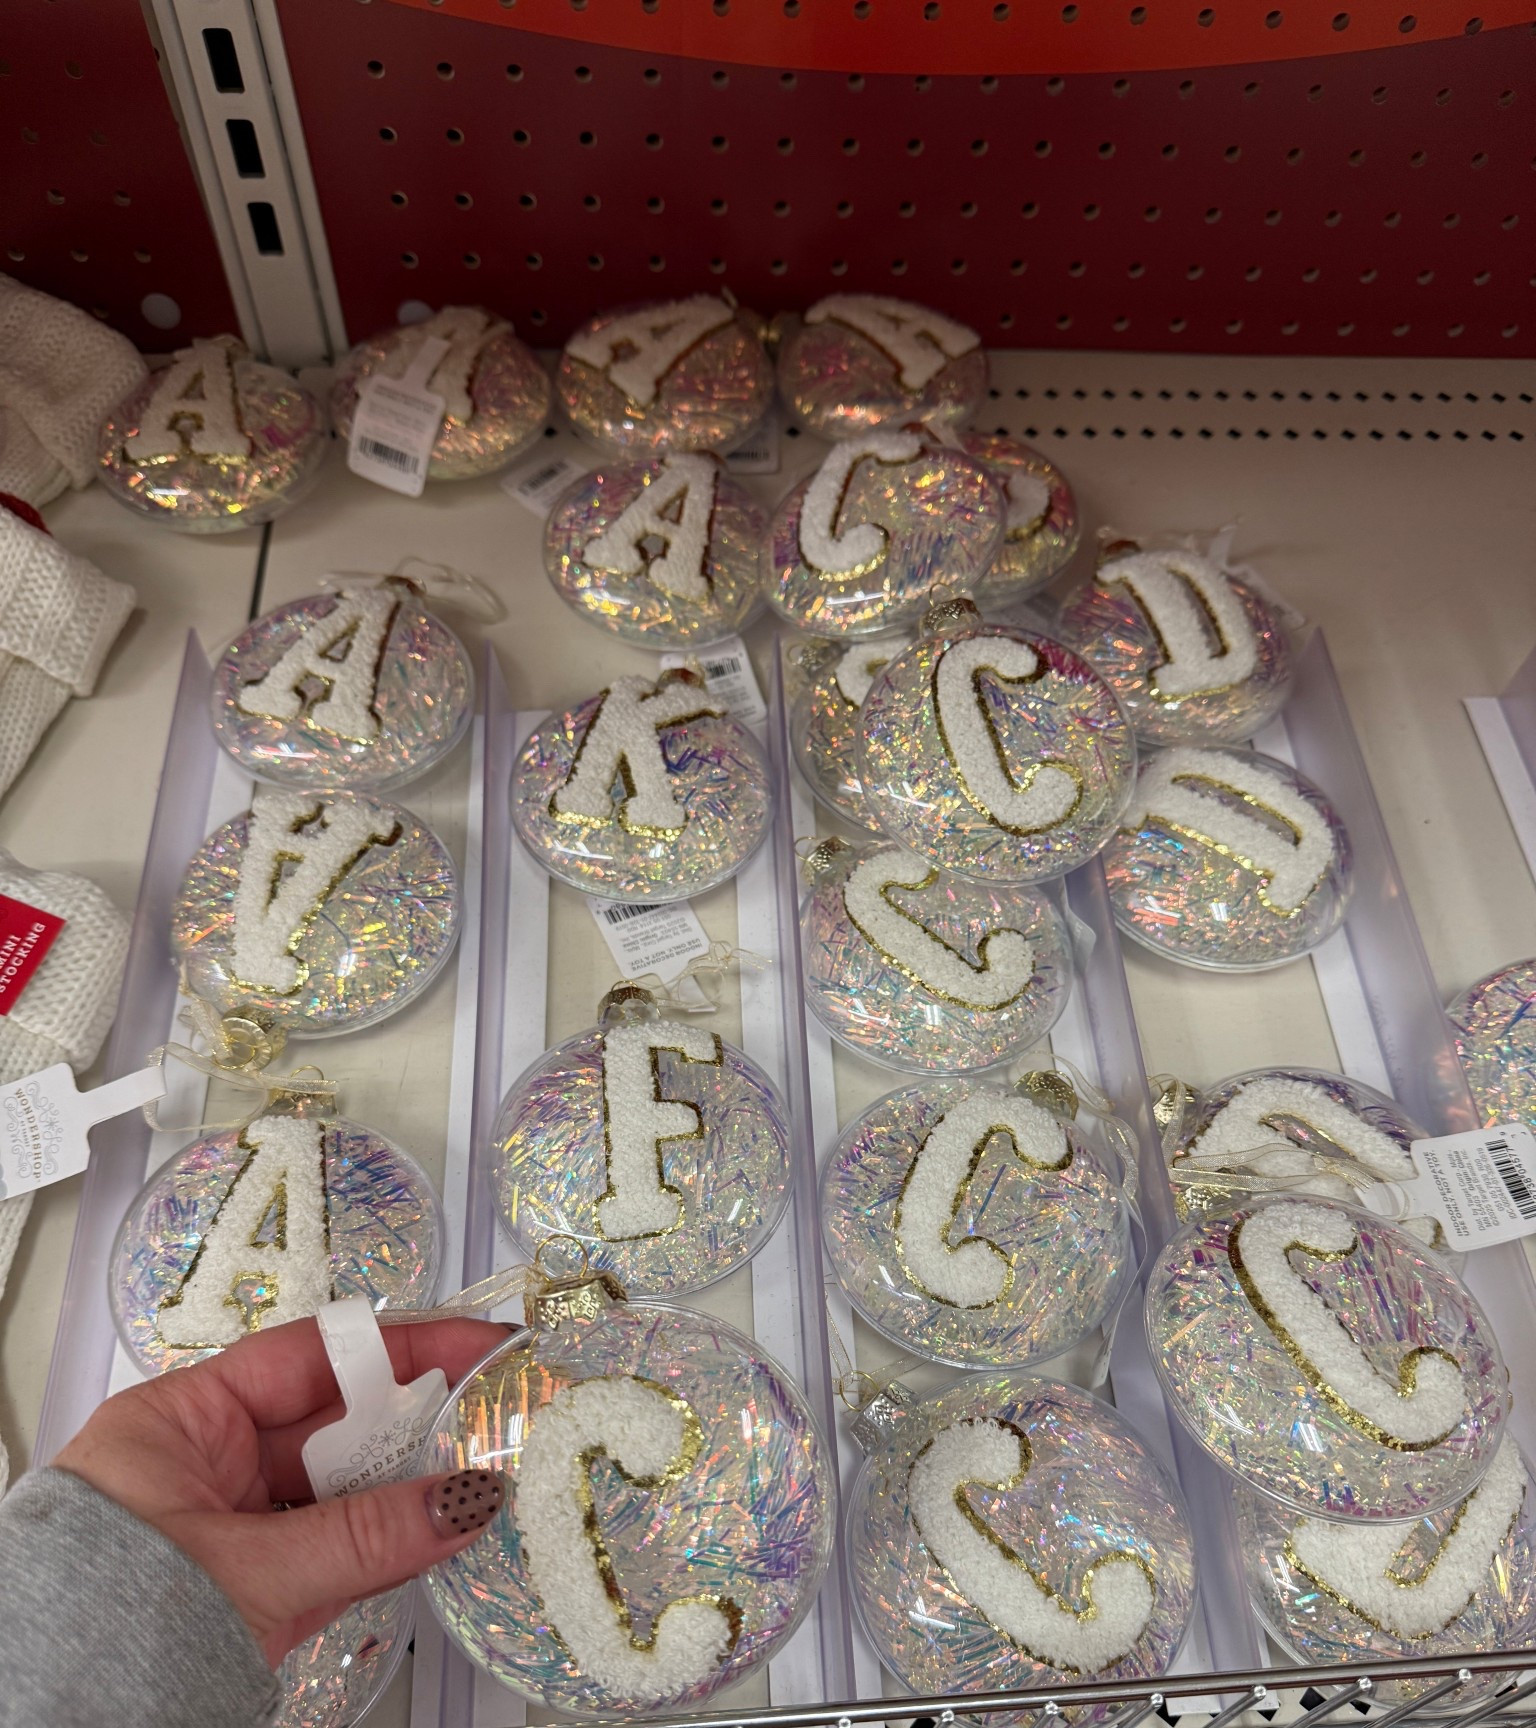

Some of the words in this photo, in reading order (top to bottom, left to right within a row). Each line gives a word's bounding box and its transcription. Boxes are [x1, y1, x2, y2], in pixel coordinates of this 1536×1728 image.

[564, 295, 737, 410] A
[804, 294, 981, 392] A
[120, 340, 254, 462] A
[581, 451, 720, 606] A
[798, 429, 928, 582] C
[236, 587, 402, 745] A
[1094, 548, 1258, 702] D
[931, 634, 1083, 838] C
[0, 935, 21, 969] MINI
[631, 951, 675, 972] DECORATIVE
[842, 850, 1036, 1013] C
[15, 1088, 43, 1179] WONDERSHOP
[596, 1020, 722, 1242] F
[1422, 1150, 1449, 1202] DECORATIVE
[1429, 1150, 1440, 1166] TOY.
[1451, 1149, 1465, 1168] China
[156, 1115, 336, 1350] A
[895, 1093, 1074, 1310] C
[1439, 1175, 1451, 1194] NOT
[1444, 1203, 1463, 1237] INDOOR
[1447, 1194, 1462, 1219] ONLY.
[1458, 1220, 1469, 1236] USE
[1460, 1187, 1475, 1207] Target
[1470, 1207, 1479, 1216] by
[1474, 1182, 1489, 1203] Target
[1227, 1203, 1466, 1452] C
[515, 1375, 745, 1702] C
[907, 1415, 1156, 1674] C
